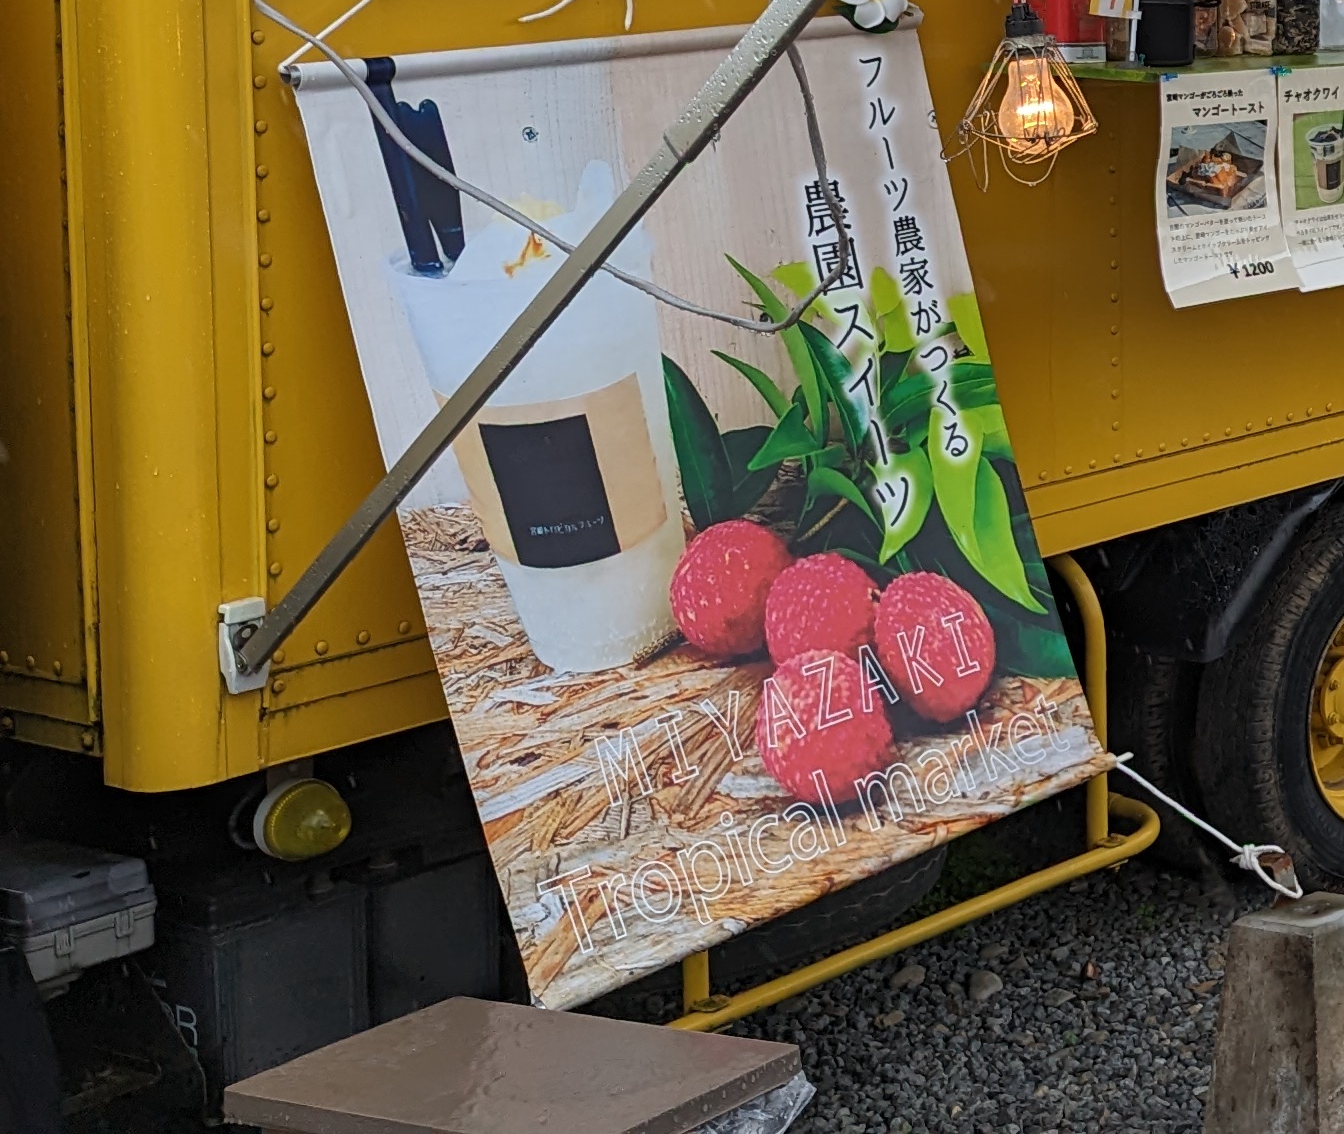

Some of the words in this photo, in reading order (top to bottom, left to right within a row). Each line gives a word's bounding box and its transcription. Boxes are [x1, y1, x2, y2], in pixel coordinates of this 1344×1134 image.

[1192, 101, 1265, 117] マンゴートースト
[1284, 85, 1340, 104] チャオクワイ
[802, 178, 911, 530] 農園スイーツ
[858, 54, 972, 461] フルーツ農家がつくる
[1227, 260, 1275, 279] ¥1200
[594, 609, 982, 806] MIYAZAKI
[537, 766, 846, 955] Tropical
[862, 697, 1071, 833] market
